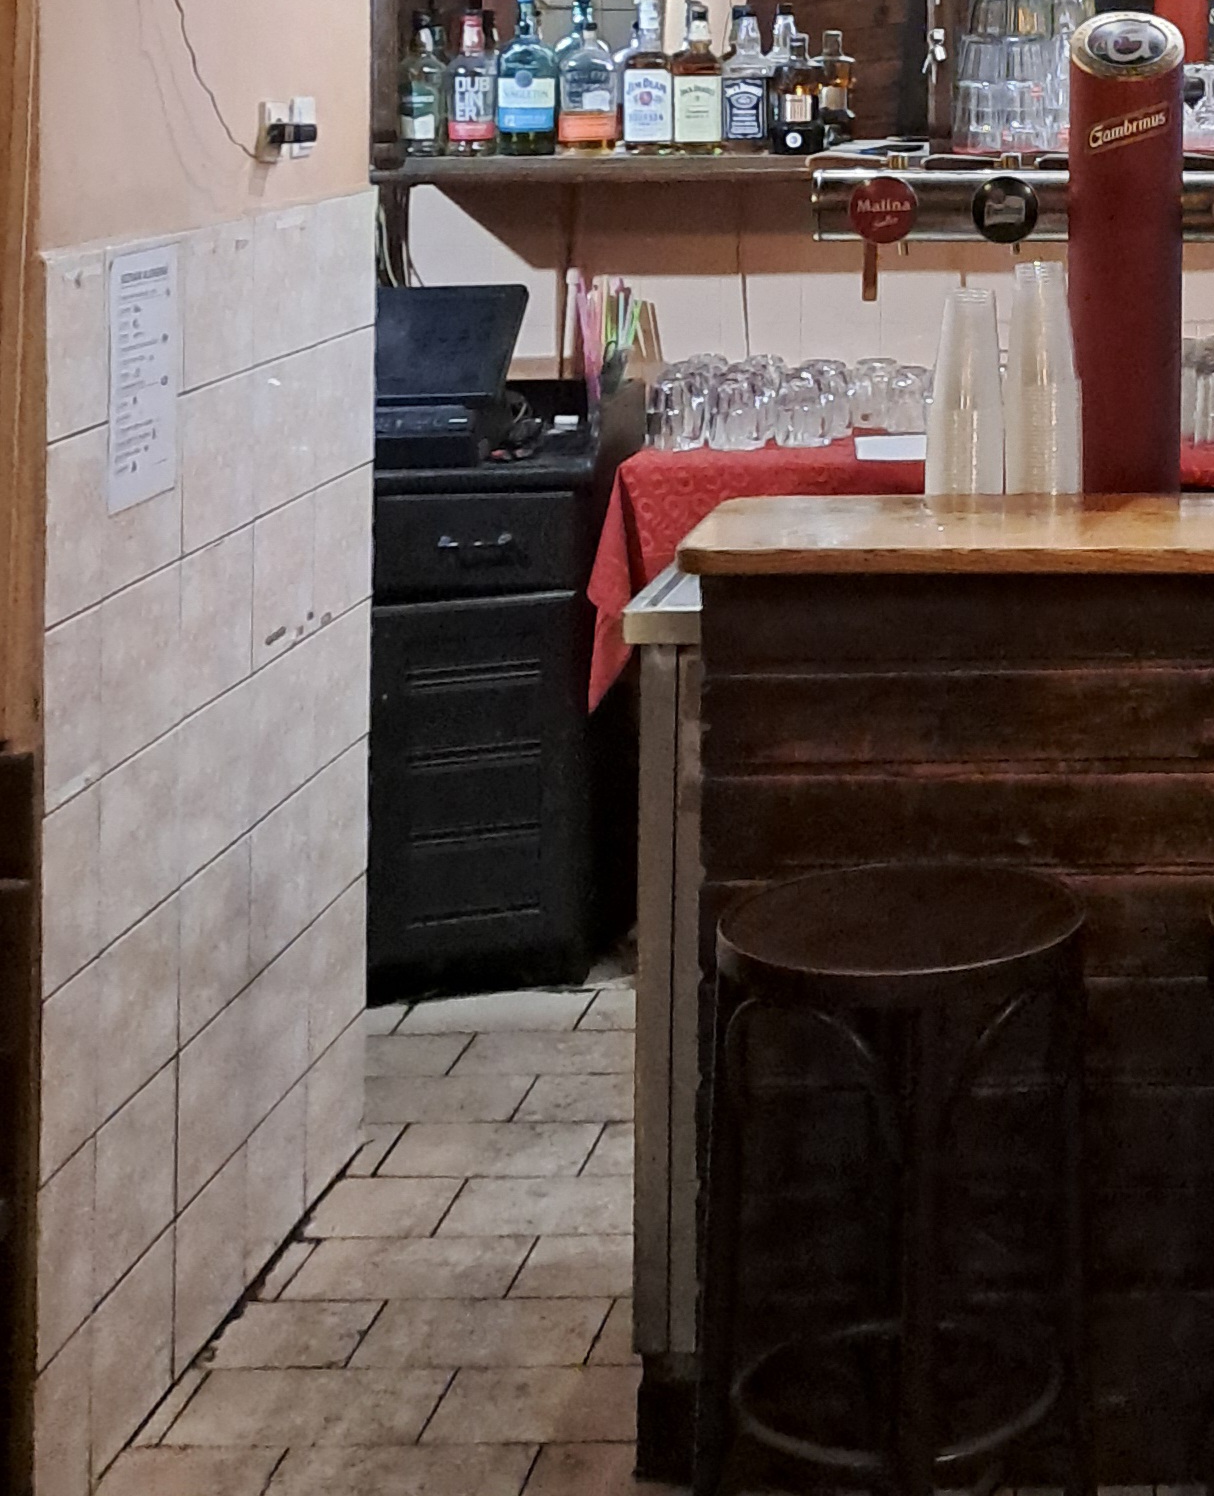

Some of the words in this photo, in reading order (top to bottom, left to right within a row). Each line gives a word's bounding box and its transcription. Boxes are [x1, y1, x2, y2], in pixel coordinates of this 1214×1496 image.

[454, 76, 491, 92] DUB
[455, 105, 478, 121] ER
[1089, 111, 1167, 148] Gambrinus
[857, 196, 912, 213] Malina
